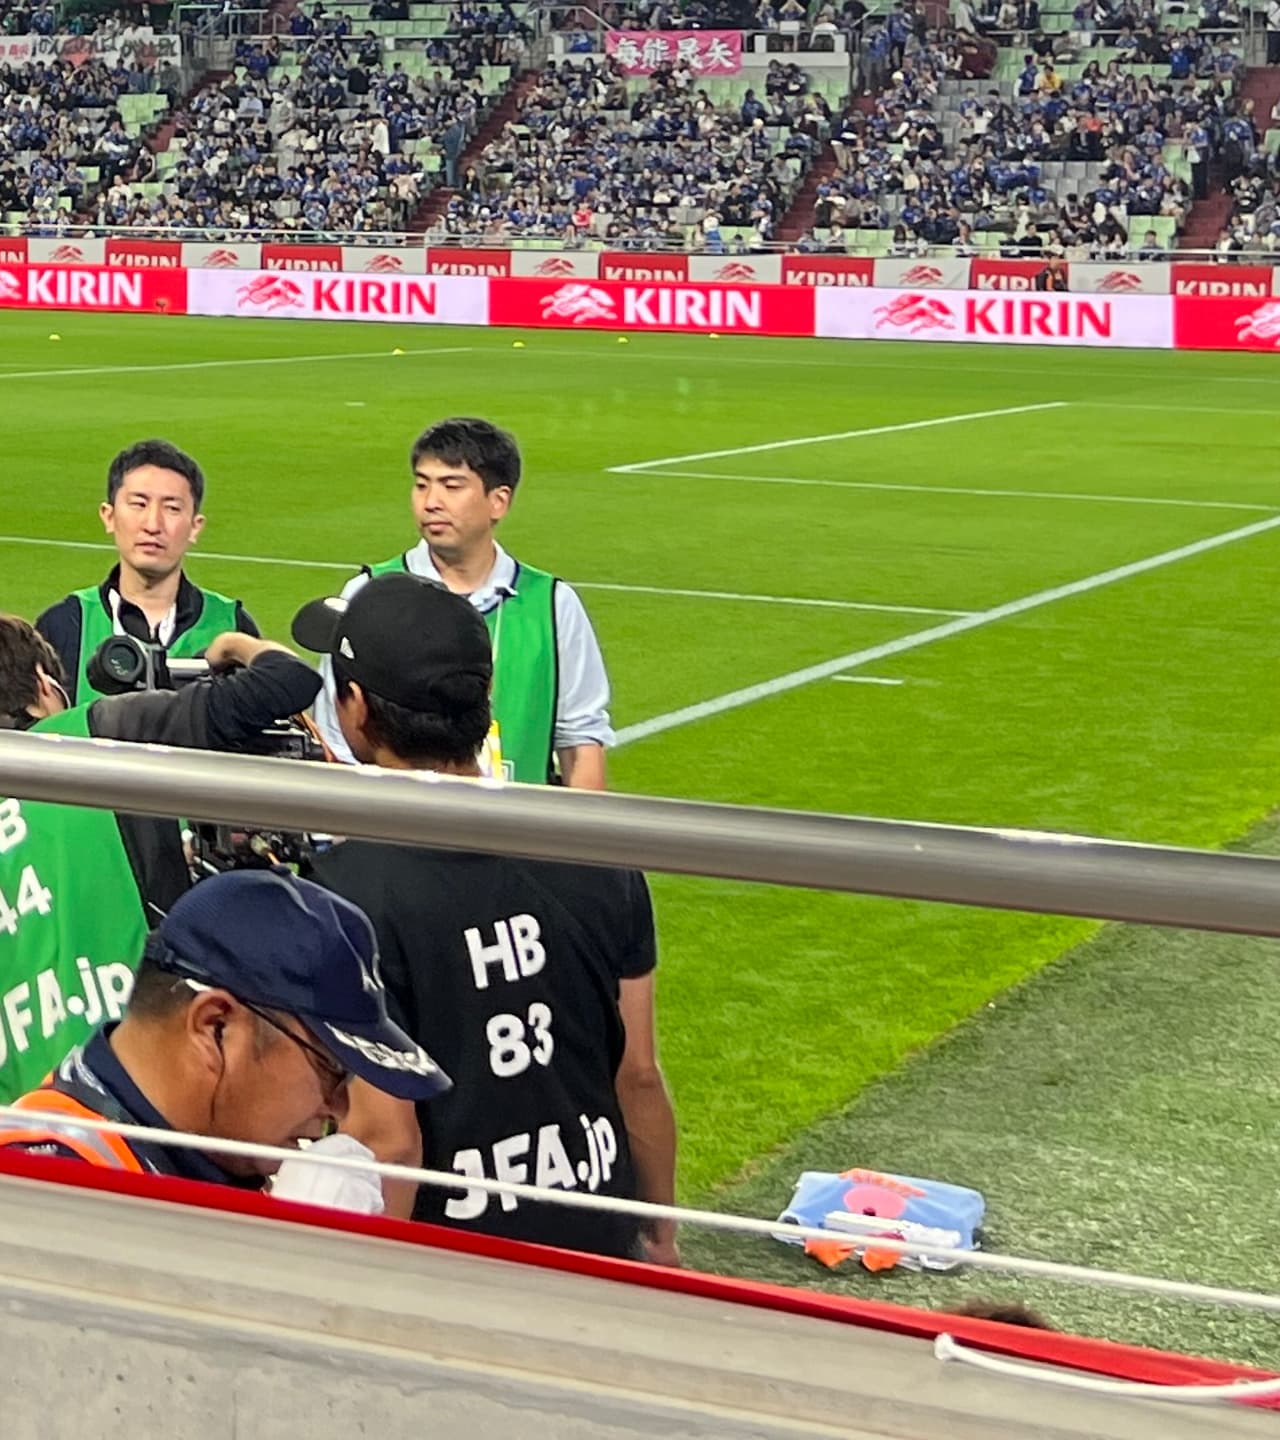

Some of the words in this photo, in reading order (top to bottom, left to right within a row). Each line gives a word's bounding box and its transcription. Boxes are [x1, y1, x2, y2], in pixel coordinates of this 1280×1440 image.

[28, 268, 142, 307] KIRIN
[313, 278, 438, 316] KIRIN
[623, 287, 761, 328] KIRIN
[965, 298, 1112, 338] KIRIN
[463, 913, 546, 989] HB
[486, 1002, 554, 1078] 83
[444, 1113, 618, 1220] JFA.jp
